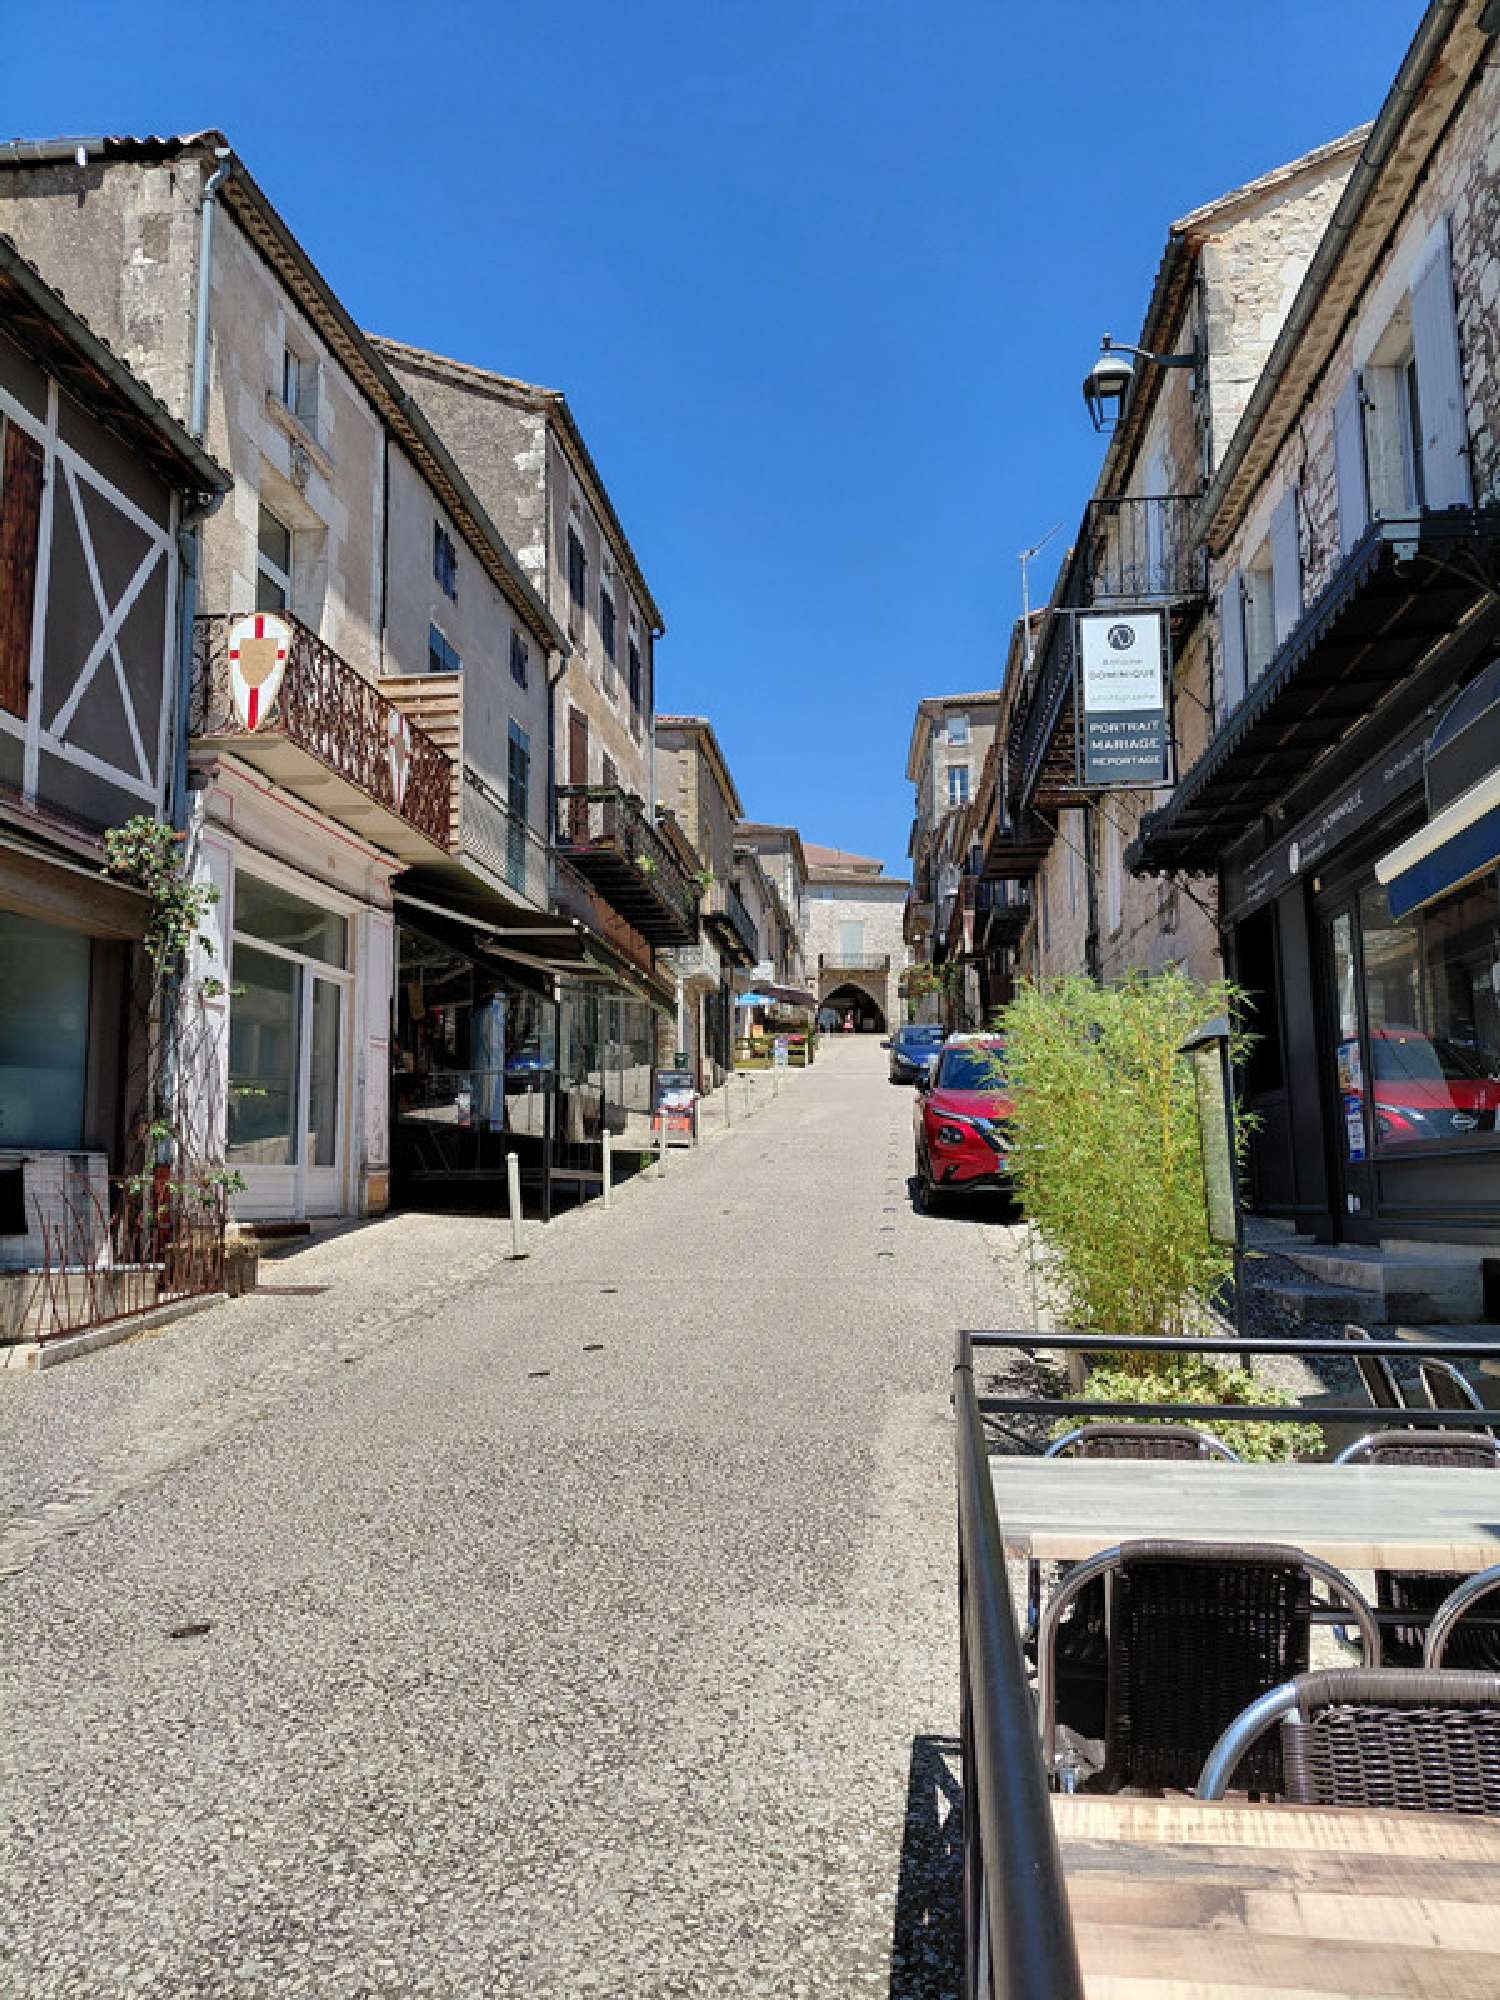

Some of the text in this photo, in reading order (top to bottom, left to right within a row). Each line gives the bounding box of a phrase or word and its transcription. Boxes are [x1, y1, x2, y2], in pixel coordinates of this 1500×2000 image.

[1090, 720, 1160, 733] PORTRAIT
[1091, 738, 1160, 750] MARIAGE
[1092, 755, 1160, 766] REPORTAGE
